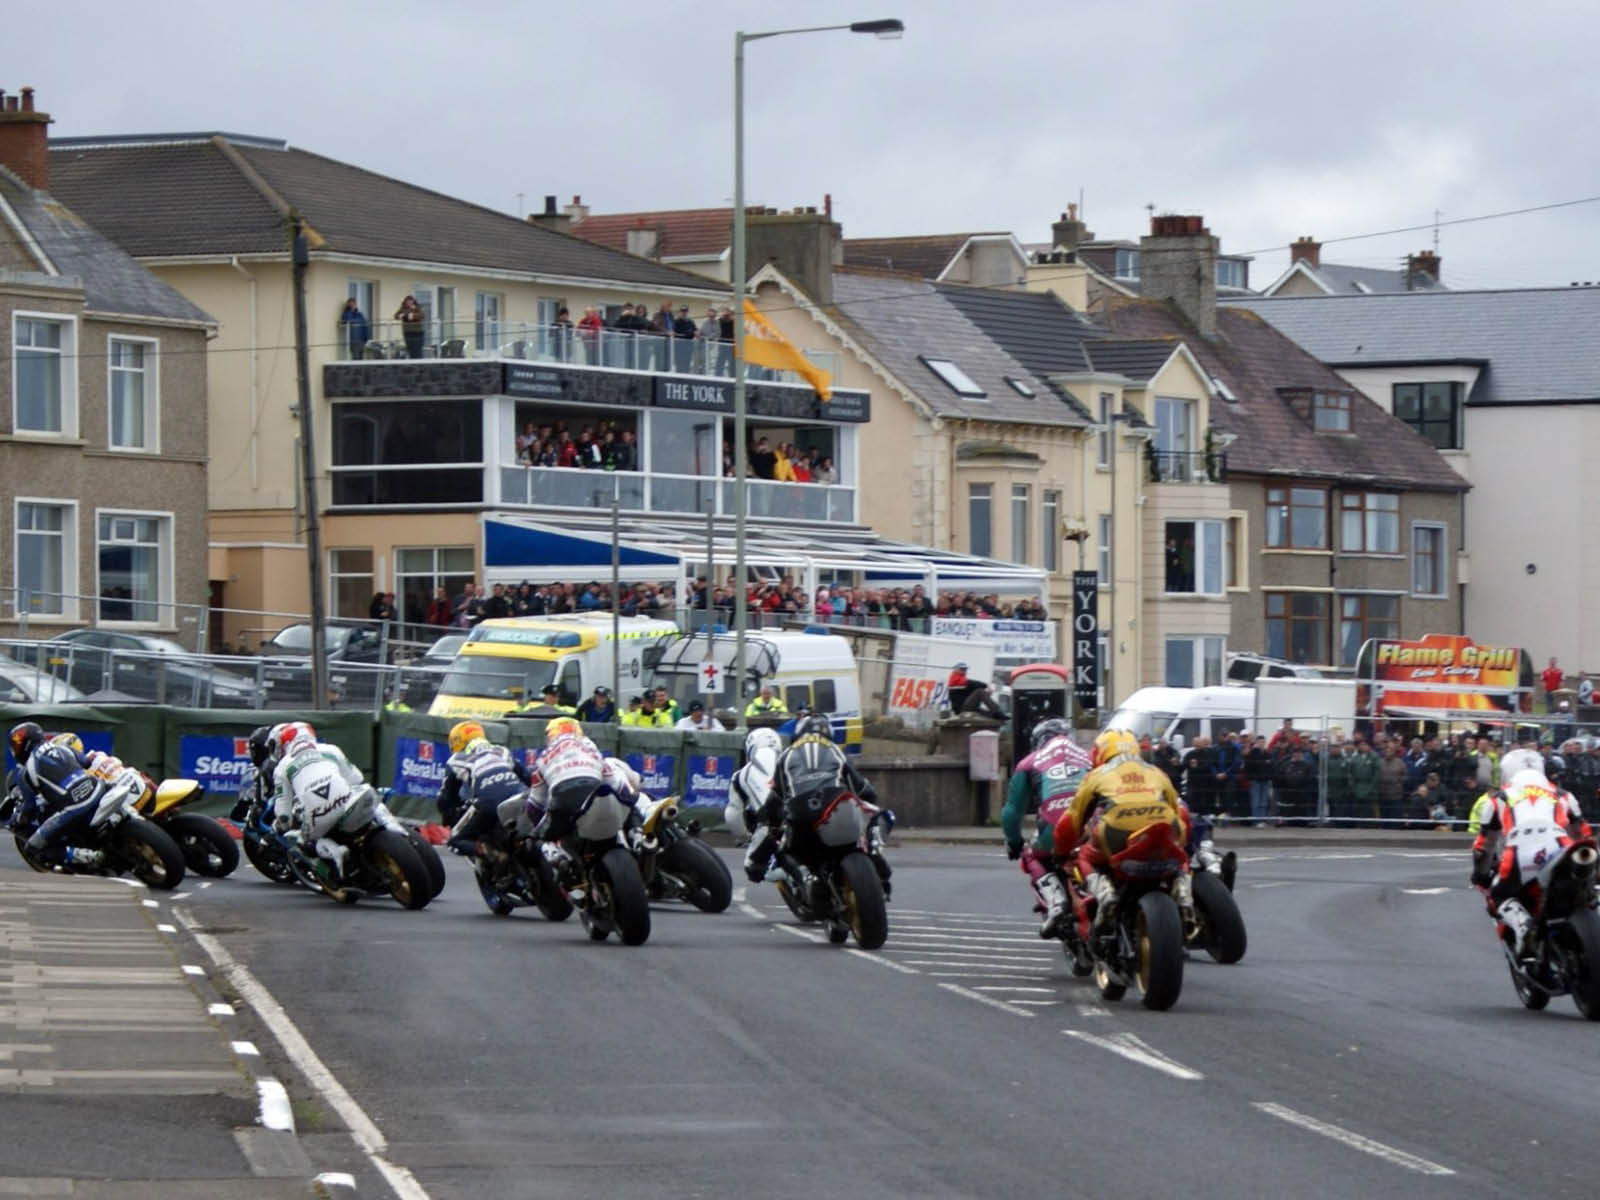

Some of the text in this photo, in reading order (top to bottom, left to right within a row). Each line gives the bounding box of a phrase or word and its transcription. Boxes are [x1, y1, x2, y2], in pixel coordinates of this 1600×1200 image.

[664, 382, 725, 404] THE YORK
[1075, 577, 1096, 587] THE
[1075, 591, 1097, 685] YORK
[1378, 643, 1515, 671] Flame Grill
[706, 679, 716, 690] 4
[194, 755, 255, 775] Sten
